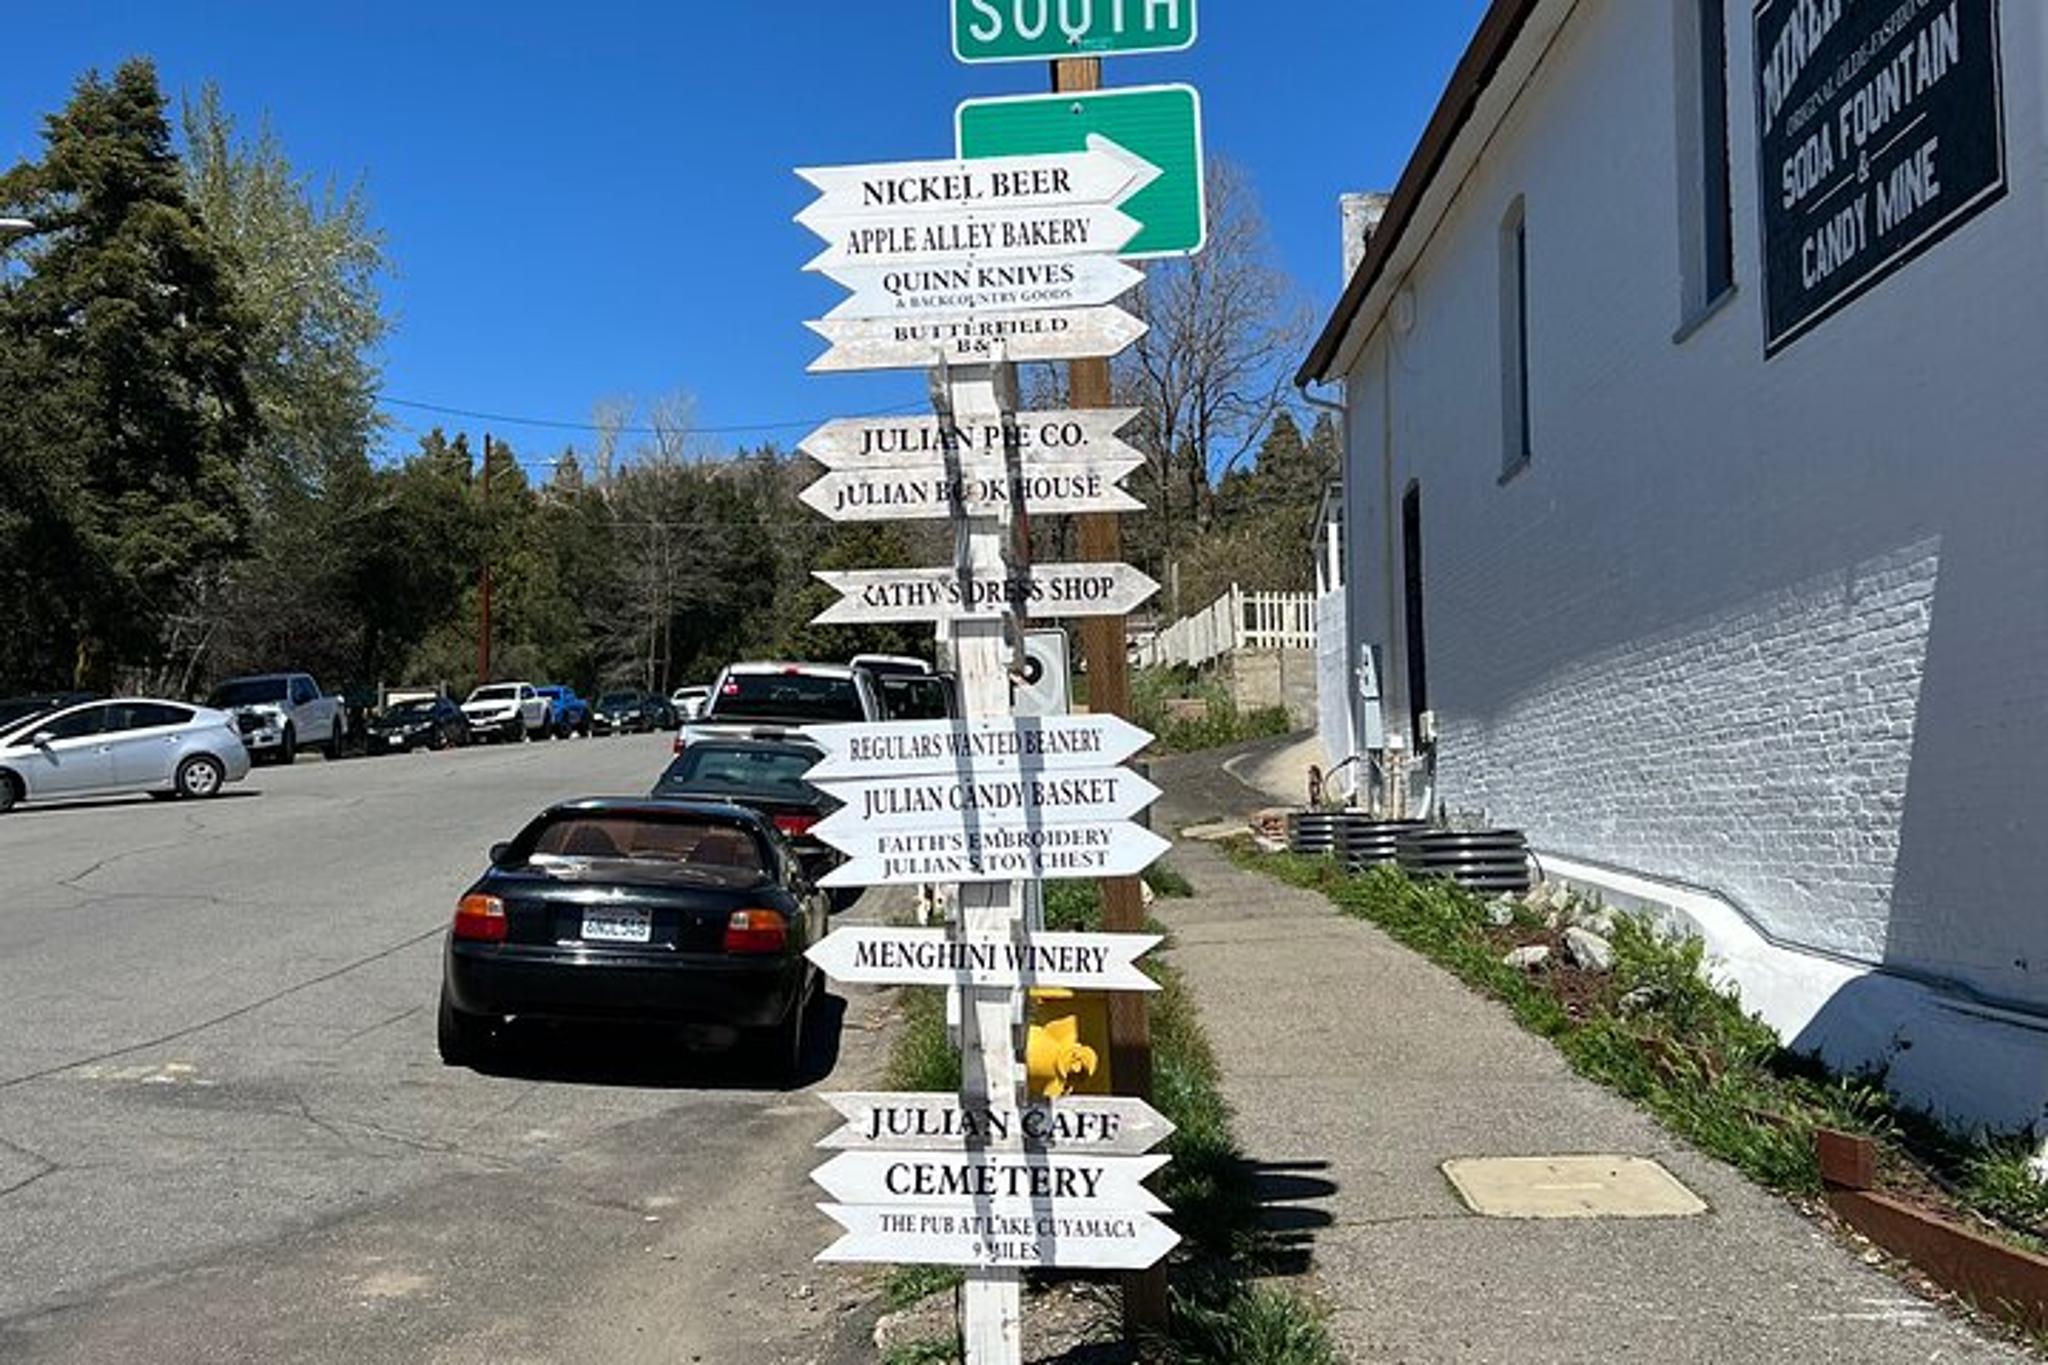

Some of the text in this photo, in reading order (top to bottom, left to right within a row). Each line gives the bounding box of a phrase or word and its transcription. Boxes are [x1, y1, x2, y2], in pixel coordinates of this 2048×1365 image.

[1782, 121, 1835, 210] SODA
[1839, 2, 1959, 161] FOUNTAIN
[1857, 150, 1870, 184] &
[862, 168, 1071, 206] NICKEL BEER
[1802, 136, 1941, 290] CANDY MINE
[847, 218, 1091, 255] APPLE ALLEY BAKERY
[883, 263, 1075, 296] QUINN KNIVES
[909, 291, 1017, 307] BACKCOUNTRY
[1021, 289, 1073, 302] GOODS
[860, 422, 1089, 455] JULIAN PIE CO.
[835, 482, 928, 510] JULIAN
[1014, 475, 1102, 501] HOUSE
[969, 579, 1044, 604] DRESS
[1051, 576, 1114, 601] SHOP
[849, 727, 1104, 762] REGULARS WANTED BEANERY
[863, 778, 1119, 820] JULIAN CANDY BASKET
[878, 828, 1114, 855] FAITH'S EMBROIDERY
[984, 852, 1027, 872] TOY
[1036, 850, 1110, 870] CHEST
[854, 940, 1110, 974] MENGHINI WINERY
[866, 1107, 1009, 1140] JULIAN
[885, 1162, 1104, 1198] CEMETERY
[880, 1214, 1137, 1239] THE PUB AT LAKE CUYAMACA
[972, 1241, 1041, 1262] 9 MILES
